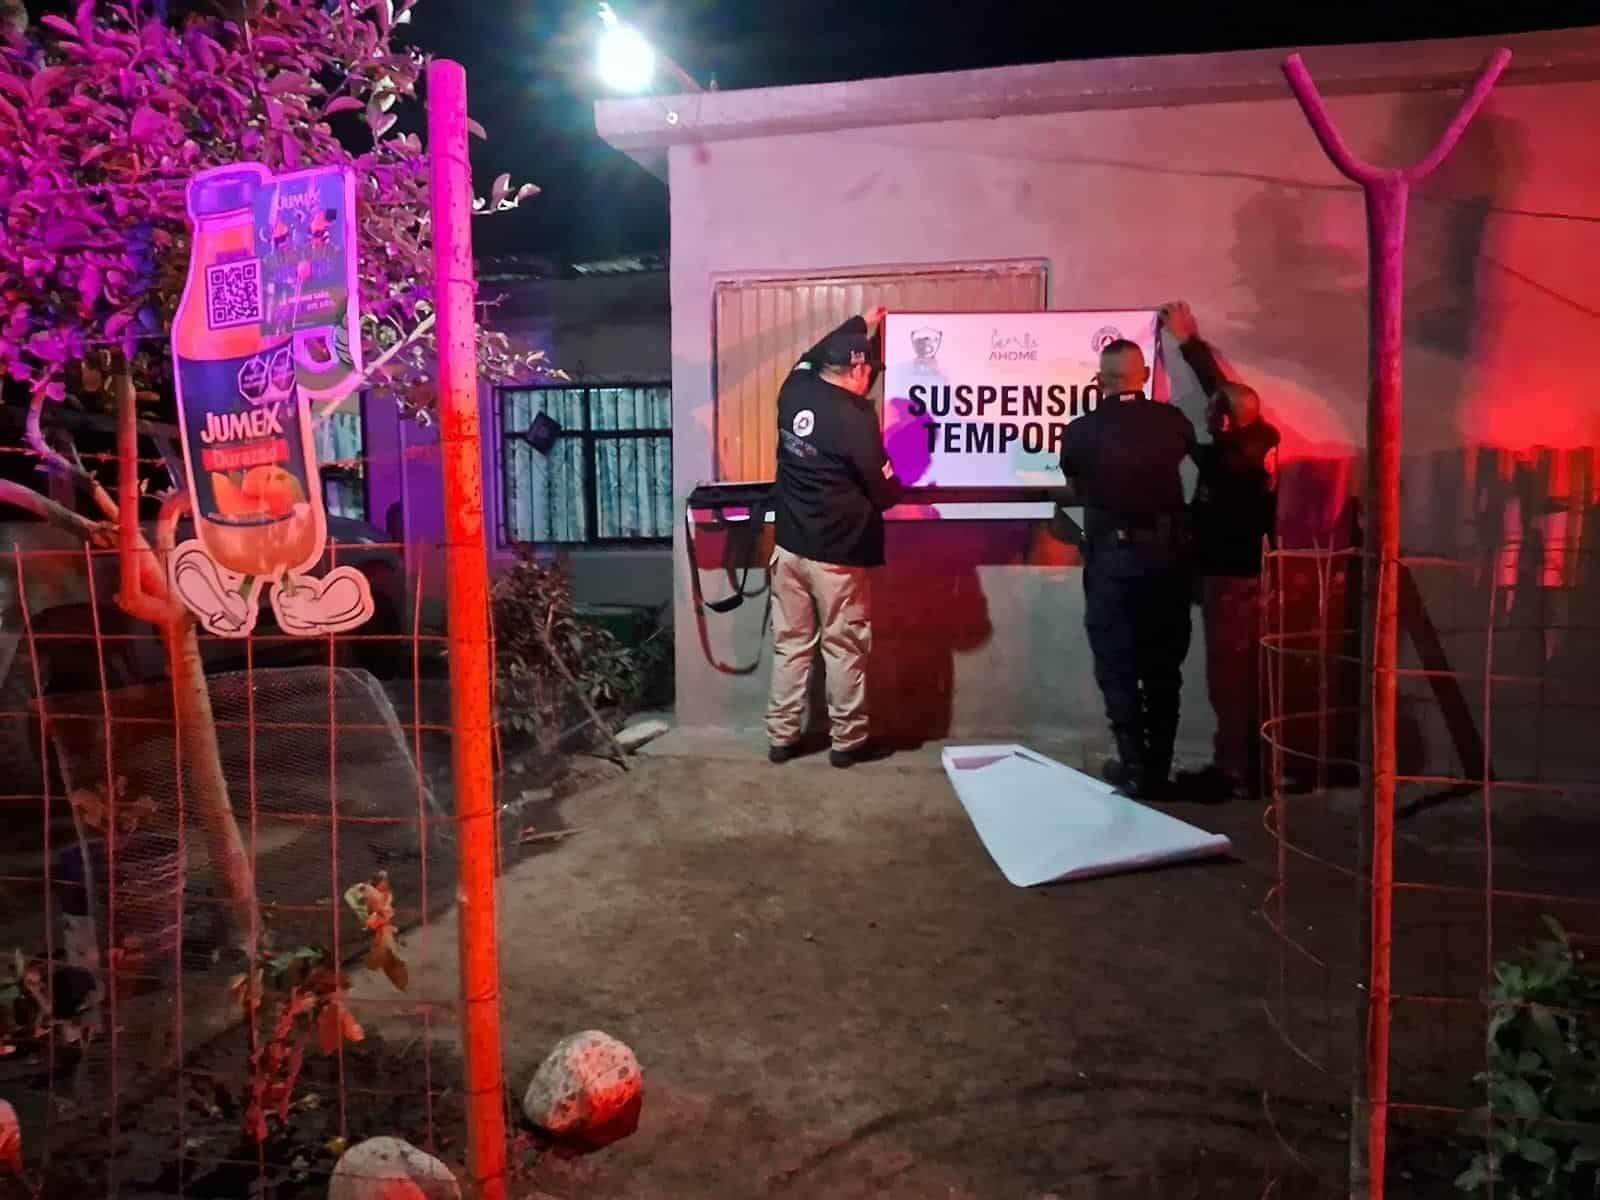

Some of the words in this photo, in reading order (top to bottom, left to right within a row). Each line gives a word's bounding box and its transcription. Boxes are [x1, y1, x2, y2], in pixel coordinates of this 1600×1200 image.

[989, 350, 1038, 361] AHOME
[908, 376, 1102, 417] SUSPENSIÓ
[200, 402, 284, 443] JUMEX
[923, 422, 1065, 454] TEMPOR
